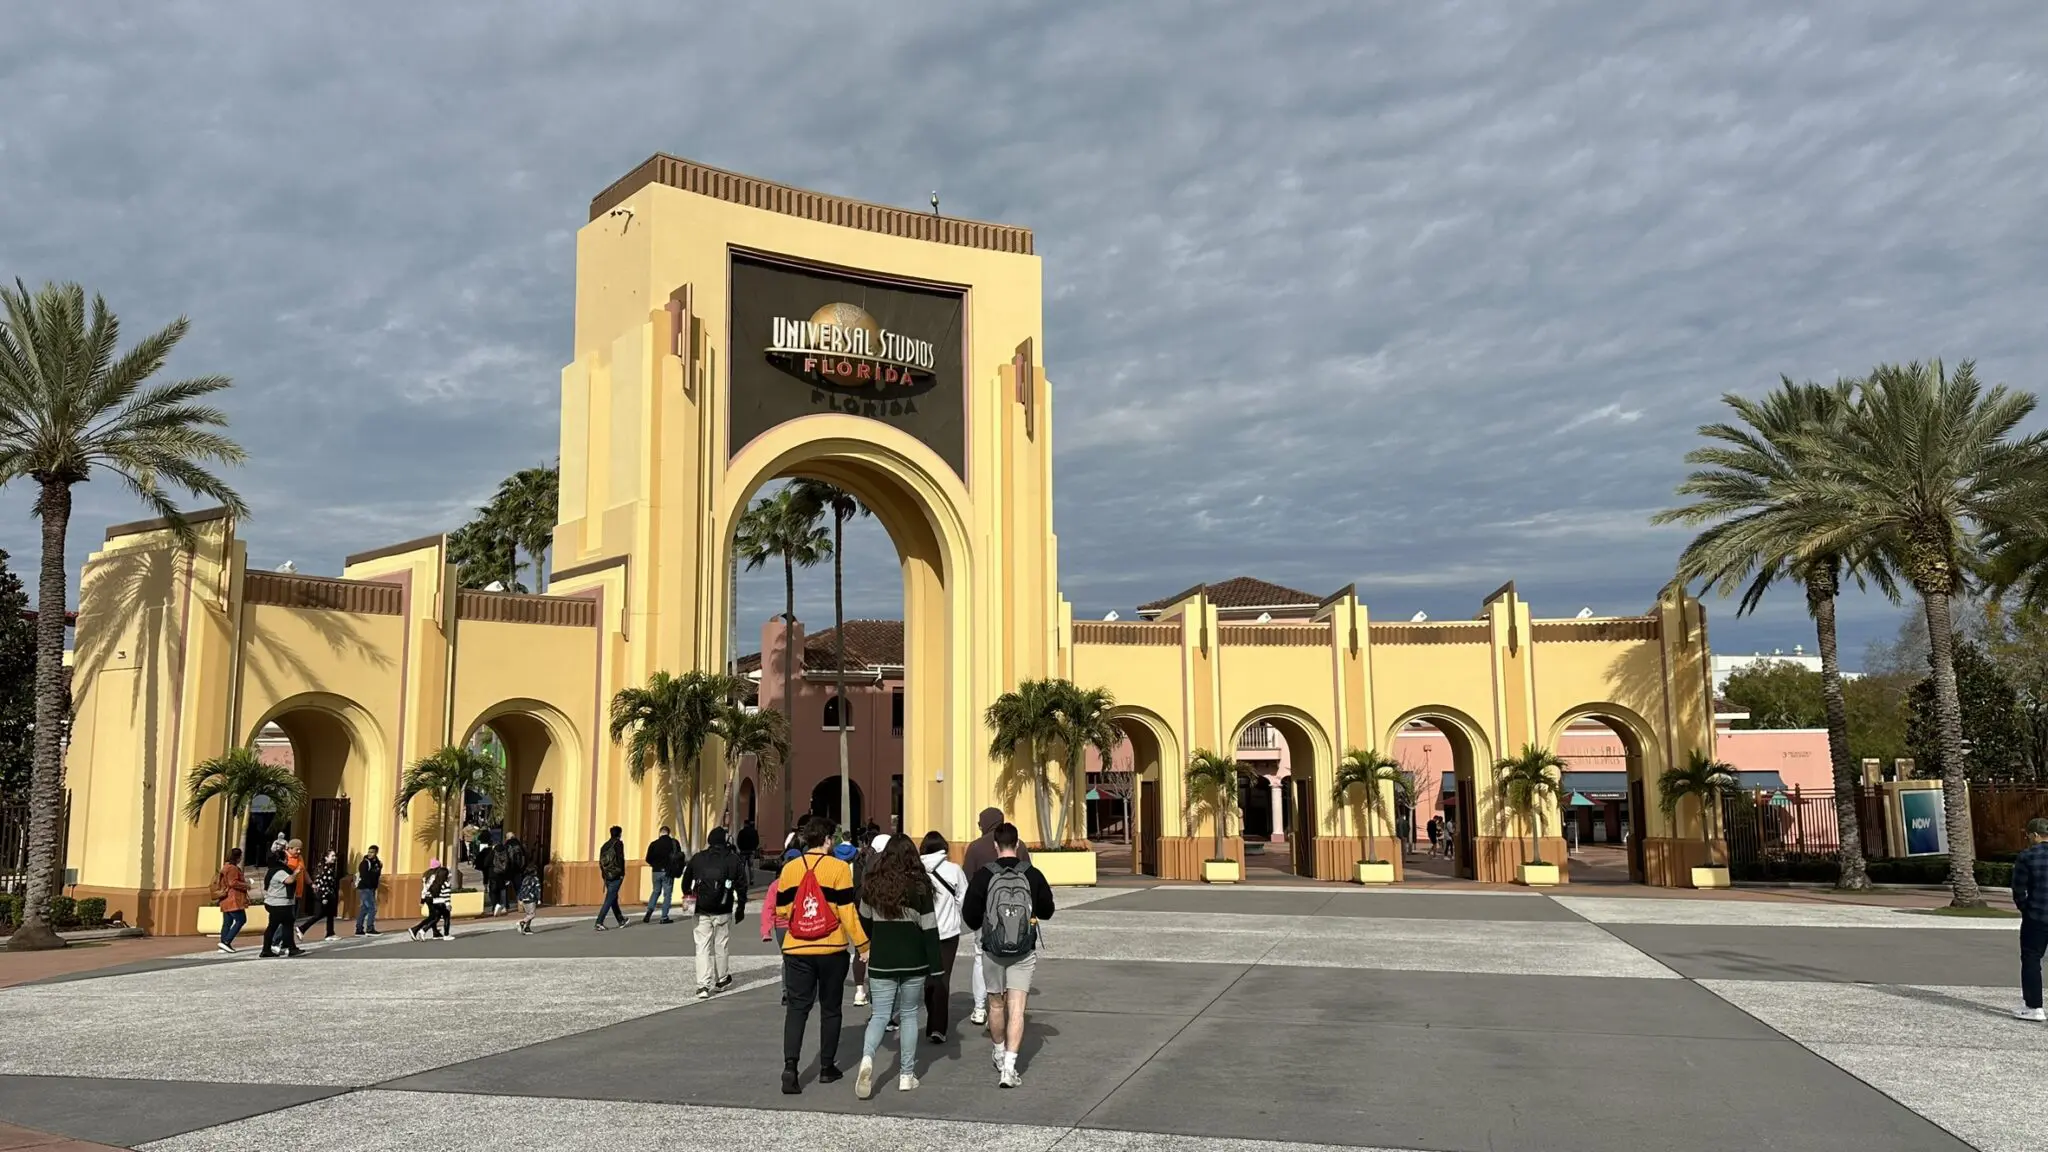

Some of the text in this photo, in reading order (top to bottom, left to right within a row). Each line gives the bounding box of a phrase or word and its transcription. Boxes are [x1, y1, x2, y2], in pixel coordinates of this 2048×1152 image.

[772, 317, 934, 369] UNIVERSAL STUDIOS
[804, 358, 913, 385] FLORIDA
[1912, 817, 1931, 829] NOW
